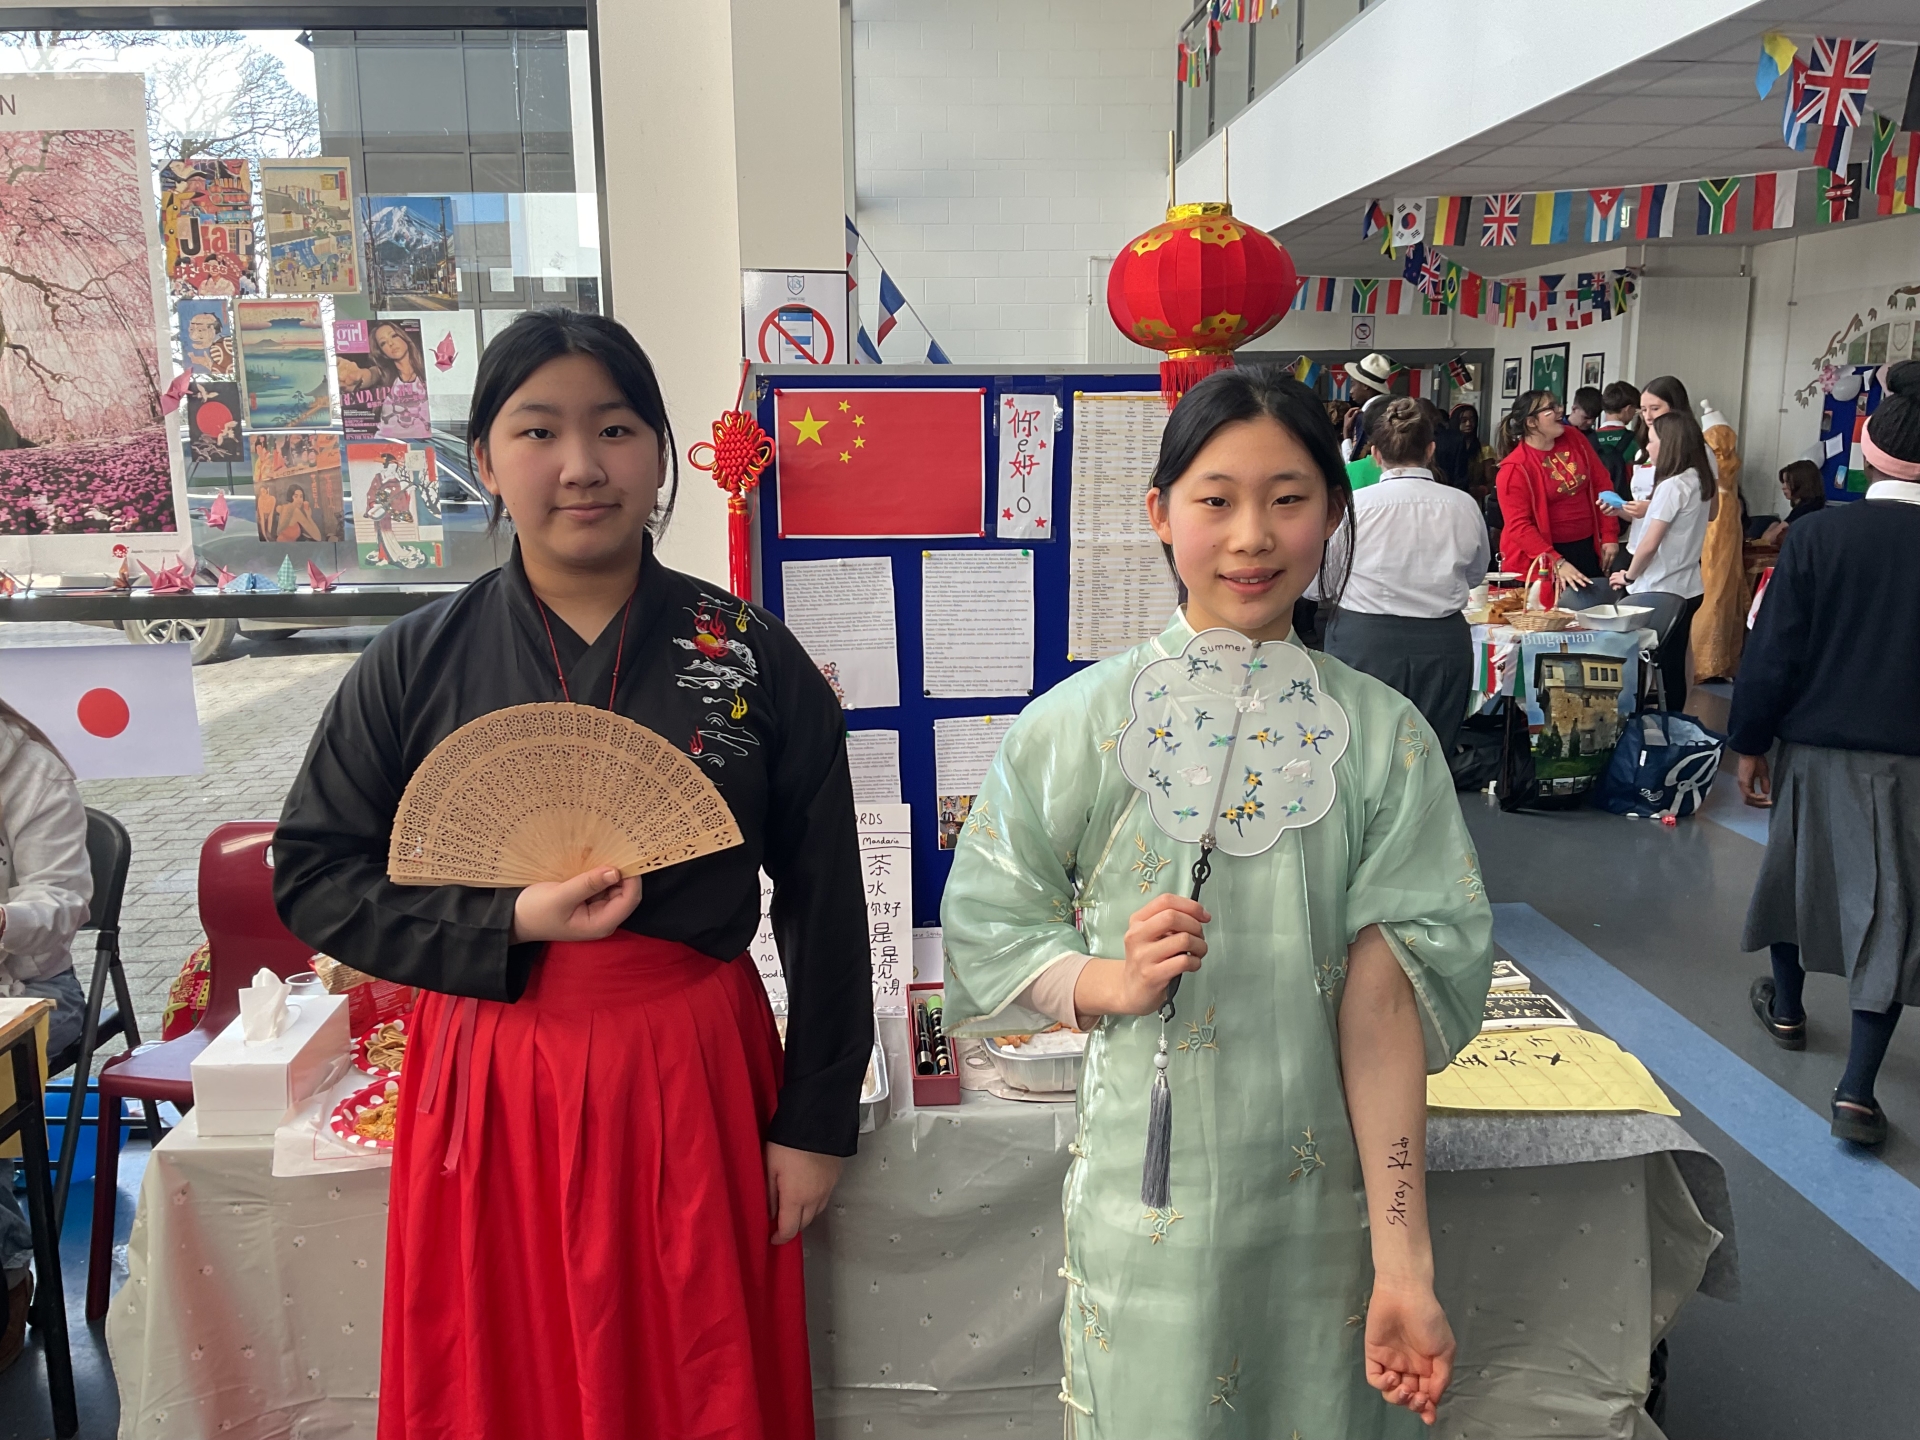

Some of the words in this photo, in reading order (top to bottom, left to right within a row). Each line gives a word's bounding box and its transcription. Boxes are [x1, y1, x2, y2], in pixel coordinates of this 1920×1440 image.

[1008, 408, 1041, 479] 你好
[1016, 411, 1032, 514] Hello
[1521, 631, 1596, 648] Bulgarian
[1199, 643, 1247, 656] Summer
[862, 837, 900, 846] Mandarin
[866, 854, 892, 876] 茶
[867, 880, 887, 897] 水
[866, 901, 902, 918] 你好
[870, 922, 893, 943] 是
[760, 953, 775, 963] no
[1387, 1136, 1413, 1170] Kids
[1385, 1179, 1414, 1227] Stray
